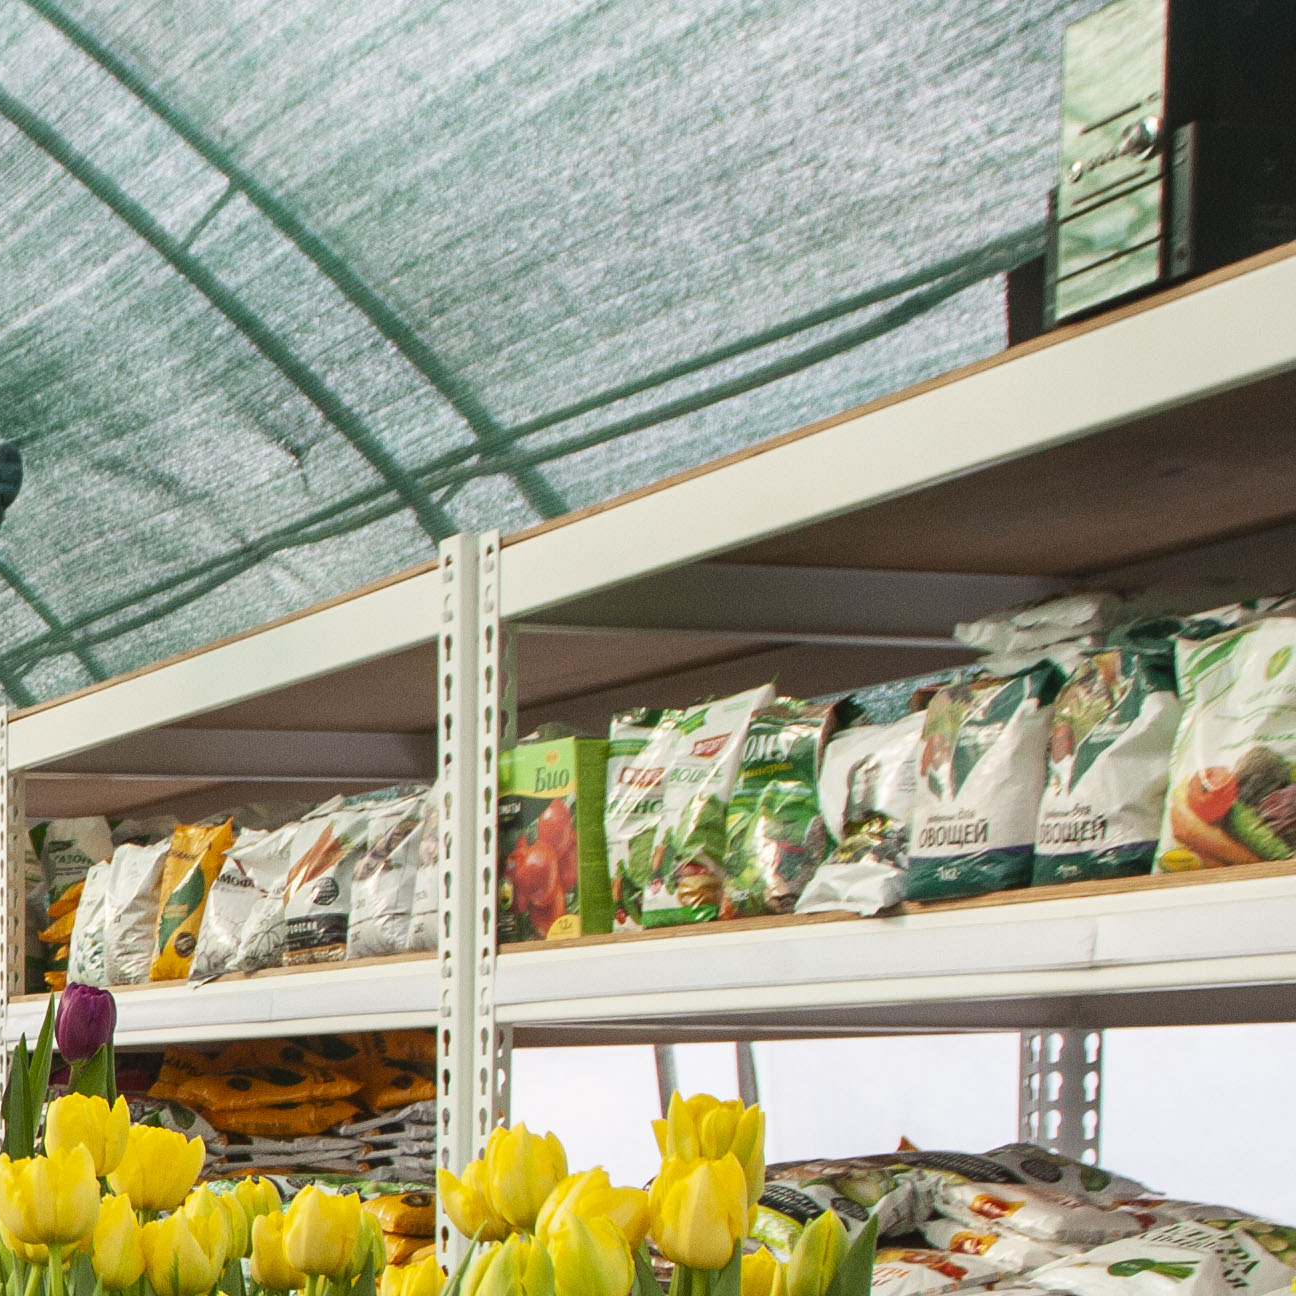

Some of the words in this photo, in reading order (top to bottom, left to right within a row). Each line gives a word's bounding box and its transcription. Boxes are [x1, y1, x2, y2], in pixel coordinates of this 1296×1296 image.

[534, 766, 569, 793] Био
[919, 818, 988, 848] ОВОЩЕЙ
[1039, 814, 1107, 846] ОВОЩЕЙ
